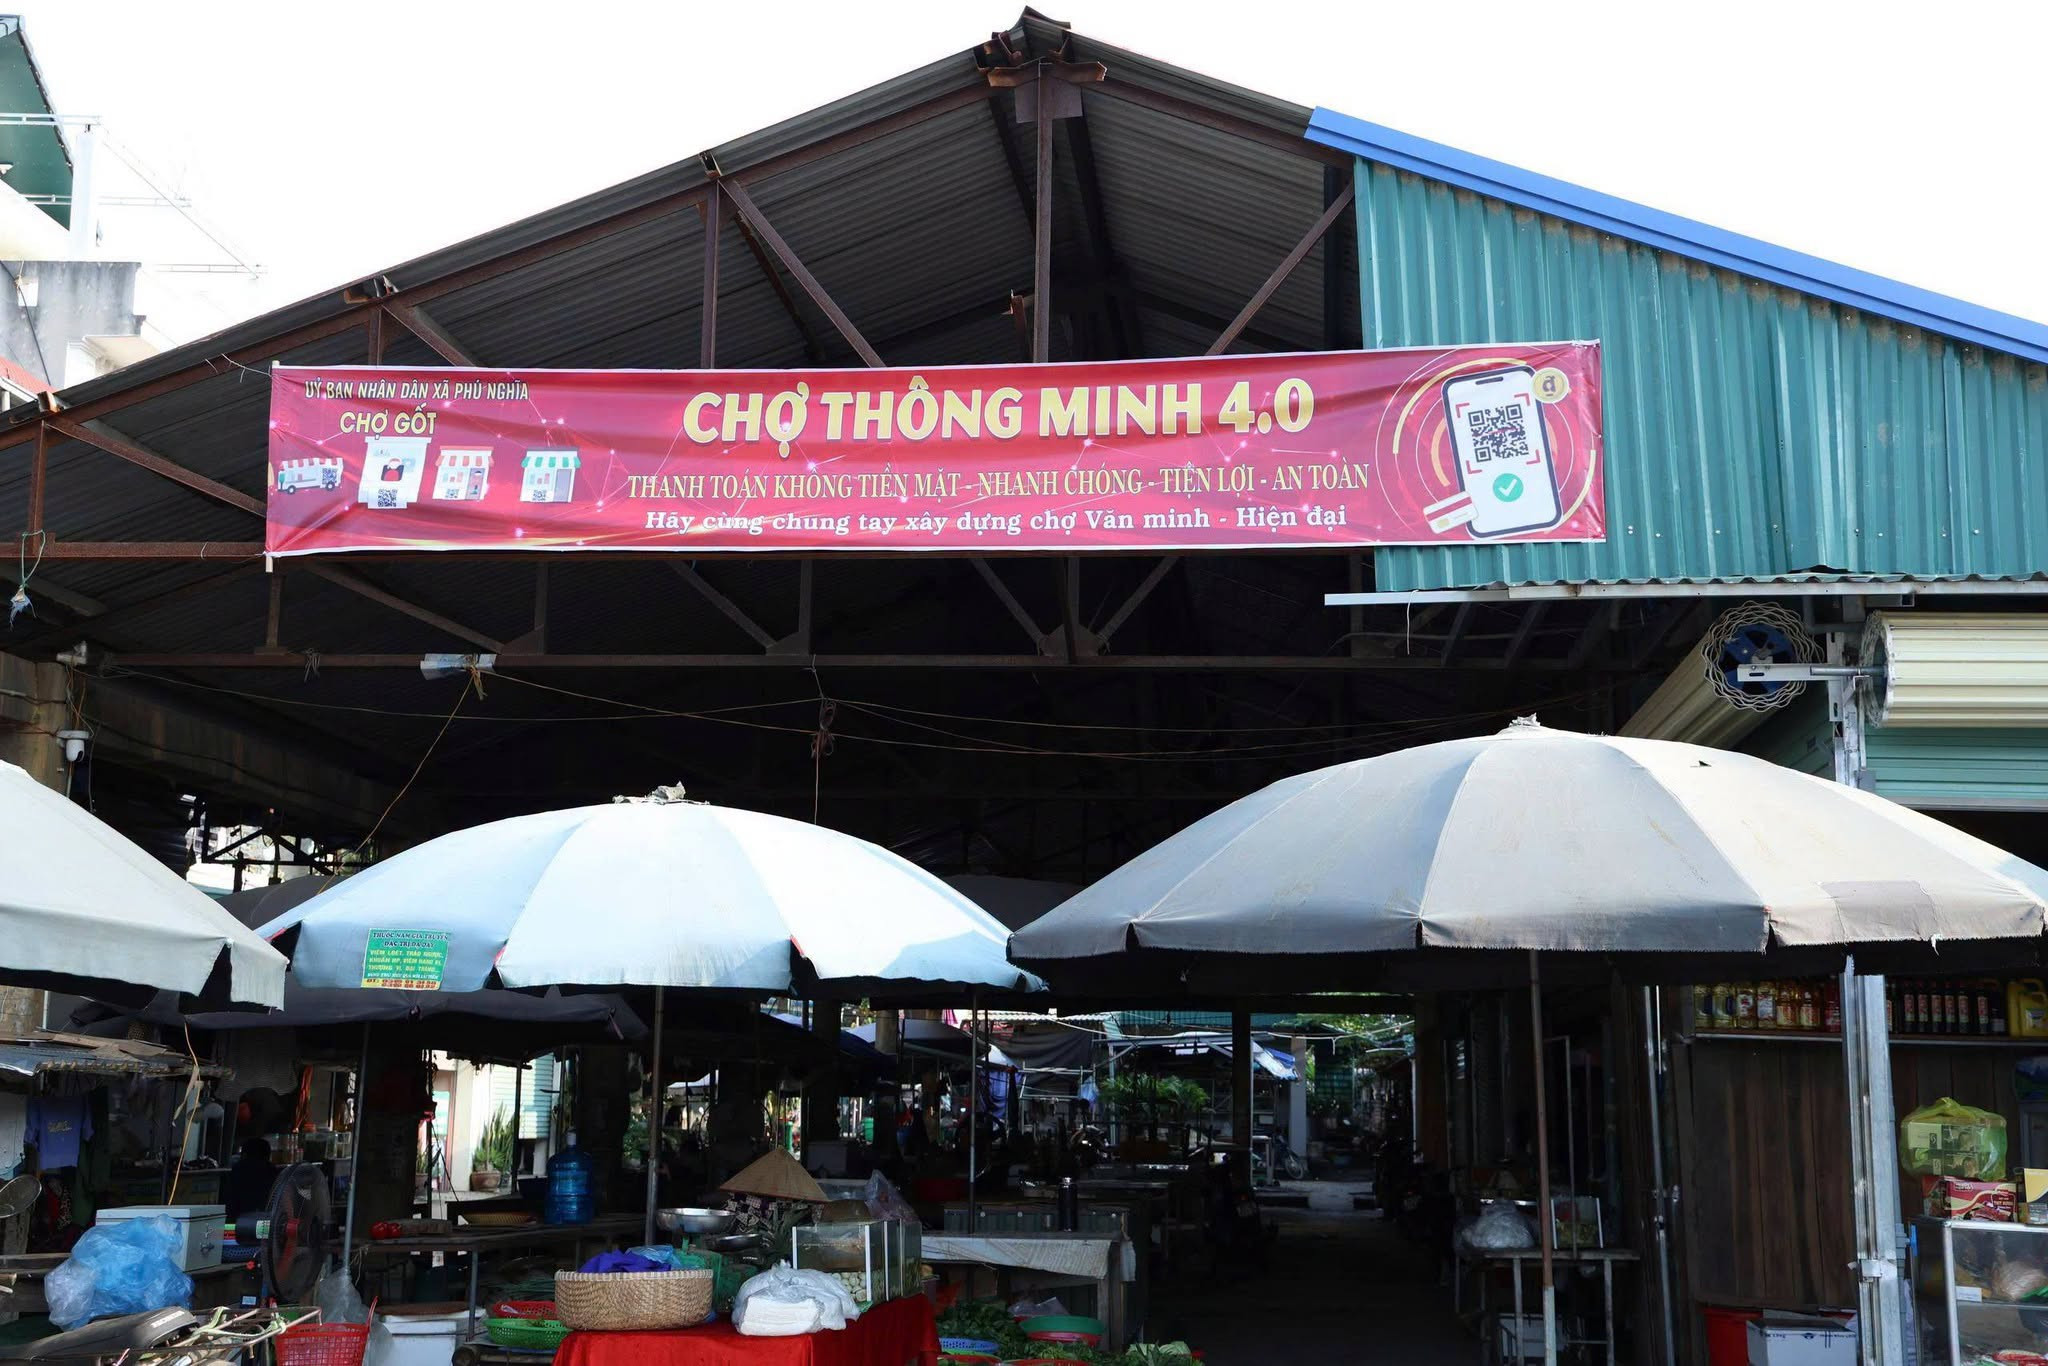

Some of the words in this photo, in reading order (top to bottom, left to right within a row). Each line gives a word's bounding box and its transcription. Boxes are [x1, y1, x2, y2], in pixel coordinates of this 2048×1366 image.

[305, 377, 322, 399] UỶ
[326, 381, 354, 399] BAN
[357, 379, 396, 400] NHÂN
[401, 379, 429, 400] DÂN
[432, 379, 449, 399] XÃ
[454, 379, 482, 400] PHÚ
[487, 379, 529, 400] NGHĨA
[339, 409, 388, 440] CHỢ
[394, 402, 437, 435] GỐT
[683, 381, 810, 458] CHỢ
[820, 375, 1023, 441] THÔNG
[1039, 383, 1203, 437] MINH
[1218, 378, 1315, 434] 4.0
[628, 475, 705, 499] THANH
[710, 468, 769, 499] TOÁN
[773, 467, 853, 499] KHÔNG
[857, 462, 908, 499] TIỀN
[914, 468, 961, 503] MẶT
[978, 471, 1059, 497] NHANH
[1064, 463, 1143, 496] CHÓNG
[1160, 460, 1212, 499] TIỆN
[1217, 464, 1255, 497] LỢI
[1272, 465, 1304, 491] AN
[1308, 457, 1370, 490] TOÀN
[645, 511, 695, 534] Hãy
[703, 512, 765, 535] cùng
[772, 513, 850, 536] chung
[858, 514, 897, 535] tay
[905, 511, 949, 535] xây
[957, 511, 1022, 535] dựng
[1030, 509, 1077, 535] chợ
[1085, 509, 1134, 531] Văn
[1143, 508, 1210, 529] minh
[1236, 506, 1297, 533] Hiện
[1306, 504, 1347, 532] đại
